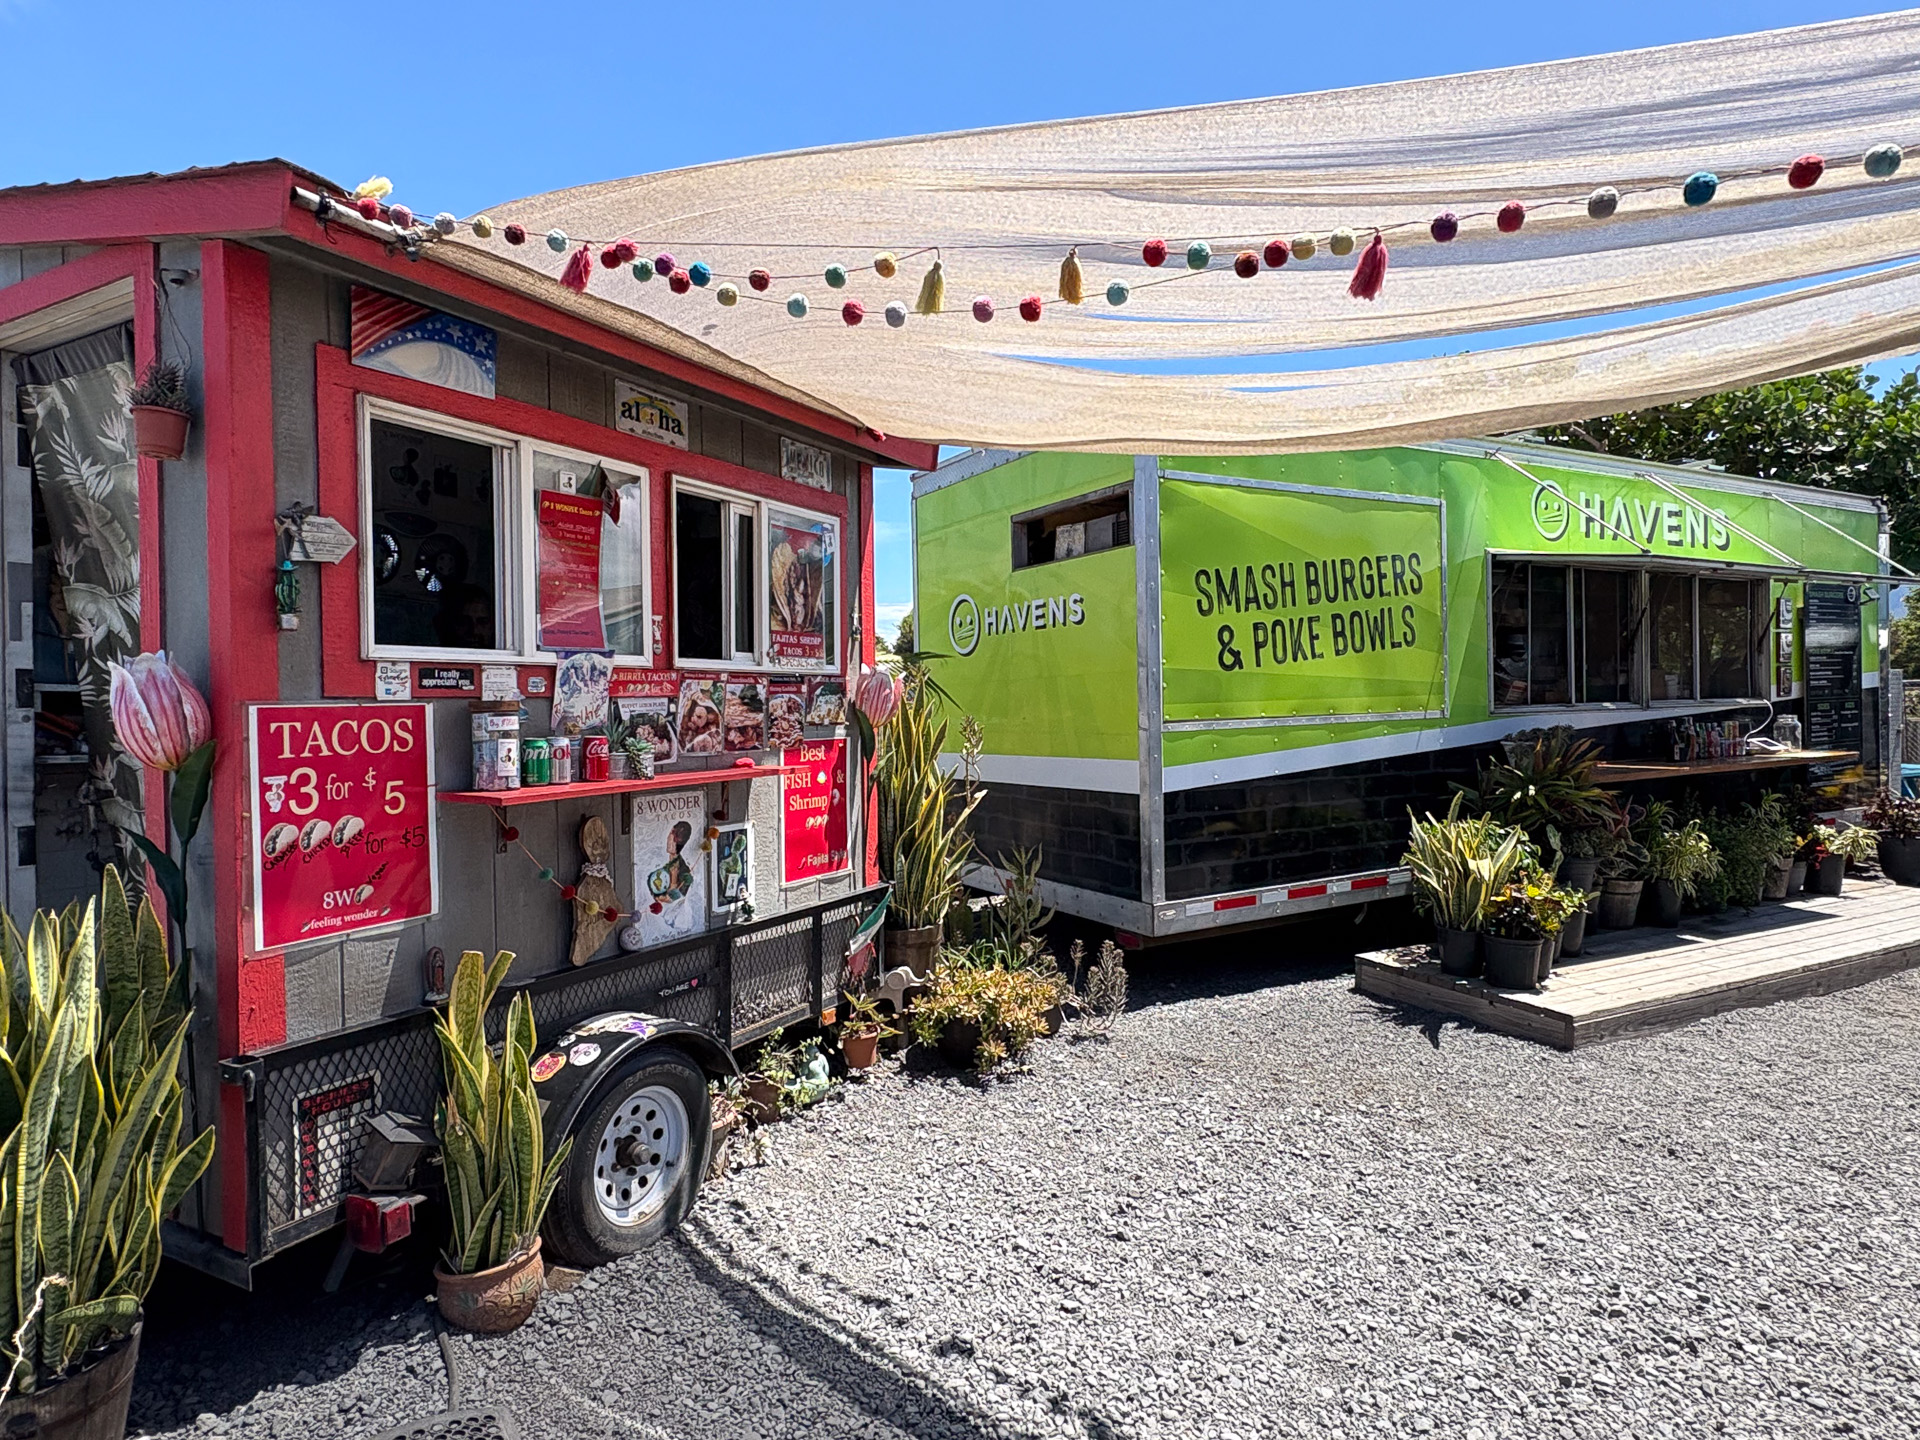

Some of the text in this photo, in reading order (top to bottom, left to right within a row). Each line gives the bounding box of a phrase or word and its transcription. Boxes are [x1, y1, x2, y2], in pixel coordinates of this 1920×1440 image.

[1579, 491, 1730, 550] HAVENS
[1194, 553, 1423, 617] SMASH BURGERS
[985, 593, 1085, 637] HAVENS
[1218, 605, 1416, 672] & POKE BOWLS
[783, 646, 803, 656] TACOS
[421, 678, 458, 688] appreciate
[435, 669, 460, 680] I really
[619, 672, 670, 681] BIRRIA TACOS
[270, 718, 414, 759] TACOS
[522, 745, 549, 763] Sprit
[800, 744, 826, 762] Best
[784, 769, 844, 790] FISH &
[288, 767, 319, 815] 3
[325, 774, 353, 801] for
[637, 795, 701, 815] 8 WONDER
[789, 793, 828, 811] Shrimp
[656, 810, 692, 822] TACOS
[365, 826, 426, 855] for $5
[807, 853, 829, 867] Fajita
[310, 907, 378, 930] feeling wonder
[658, 982, 690, 997] YOU ARE
